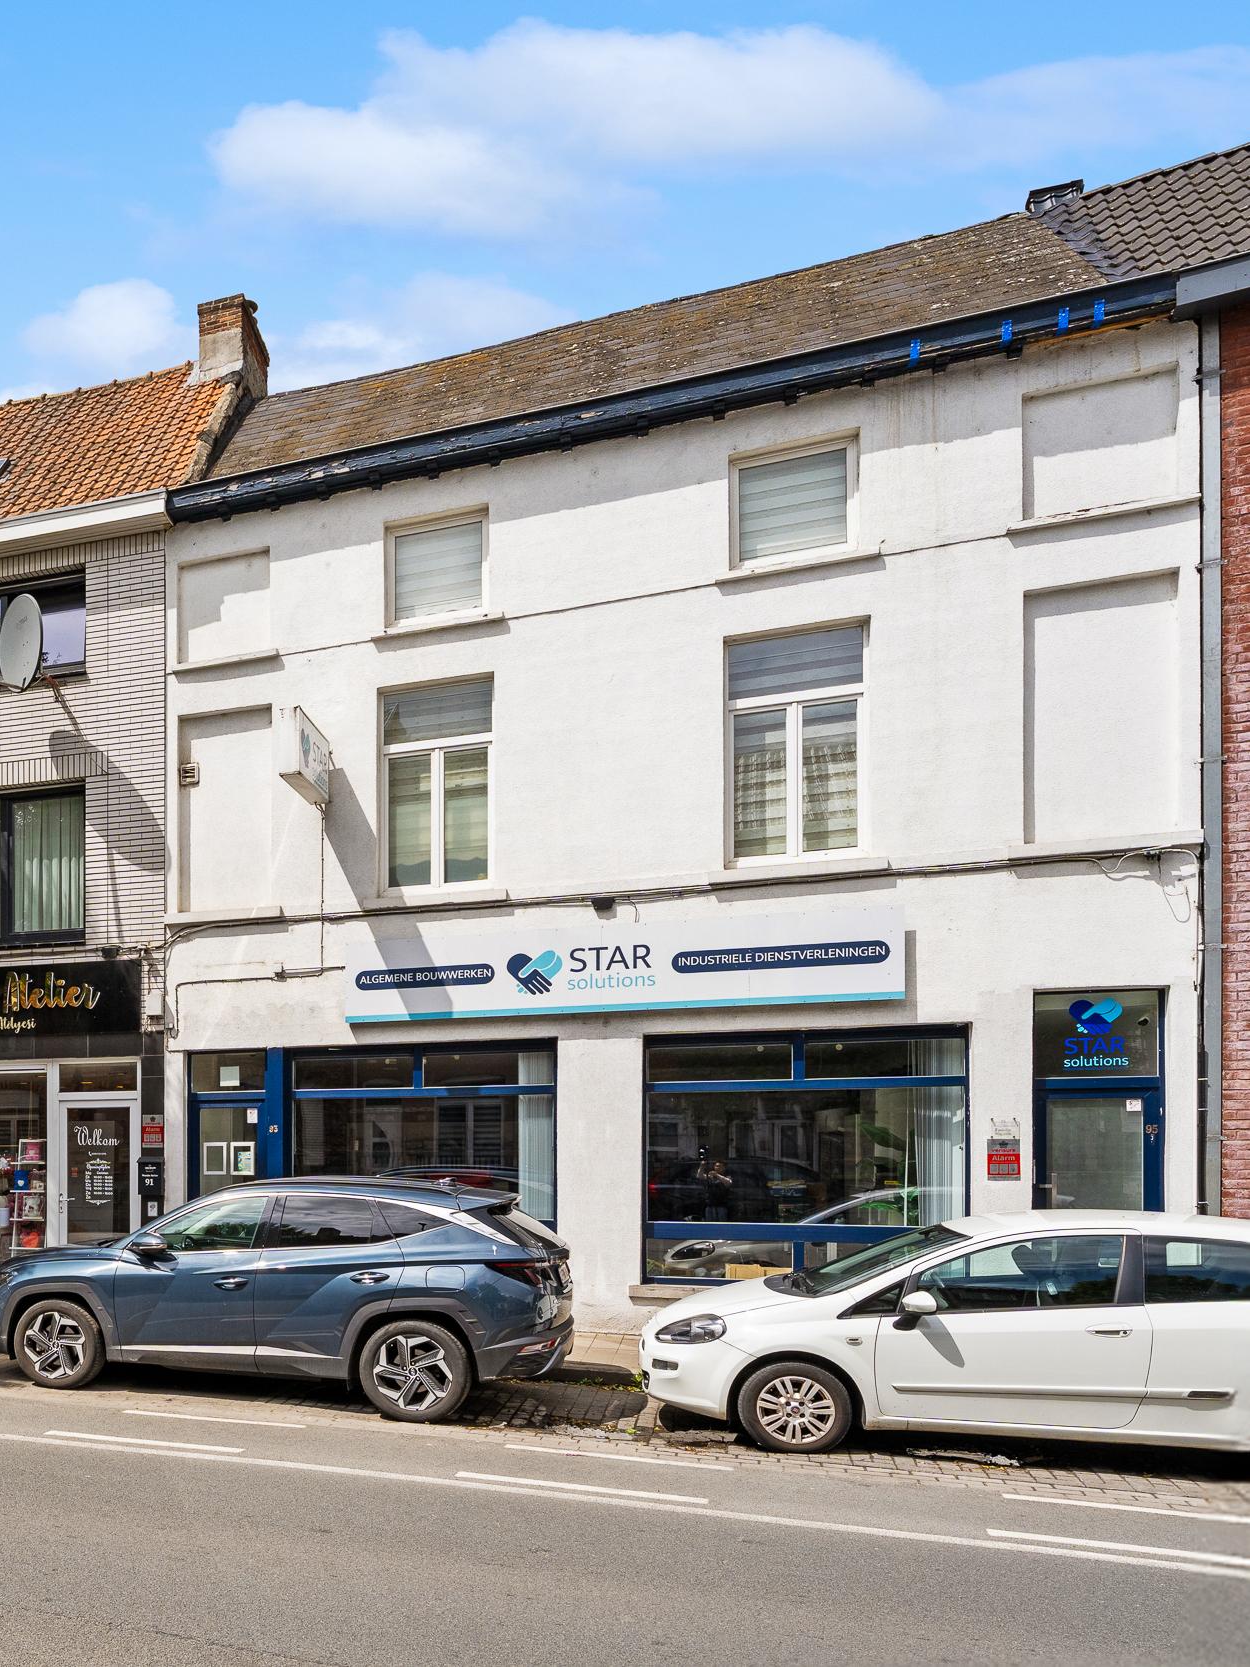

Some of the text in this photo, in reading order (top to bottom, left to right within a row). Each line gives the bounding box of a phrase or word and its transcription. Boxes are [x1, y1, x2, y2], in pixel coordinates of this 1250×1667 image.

[569, 944, 652, 973] STAR
[678, 946, 886, 967] INDUSTRIELE DIENSTVERLENINGEN
[359, 968, 492, 985] ALGEMENE BOUWWERKEN
[567, 972, 656, 991] solutions
[2, 971, 100, 1014] Atelier
[1064, 1036, 1125, 1055] STAR
[1063, 1055, 1129, 1068] solutions
[1145, 1124, 1158, 1134] 95
